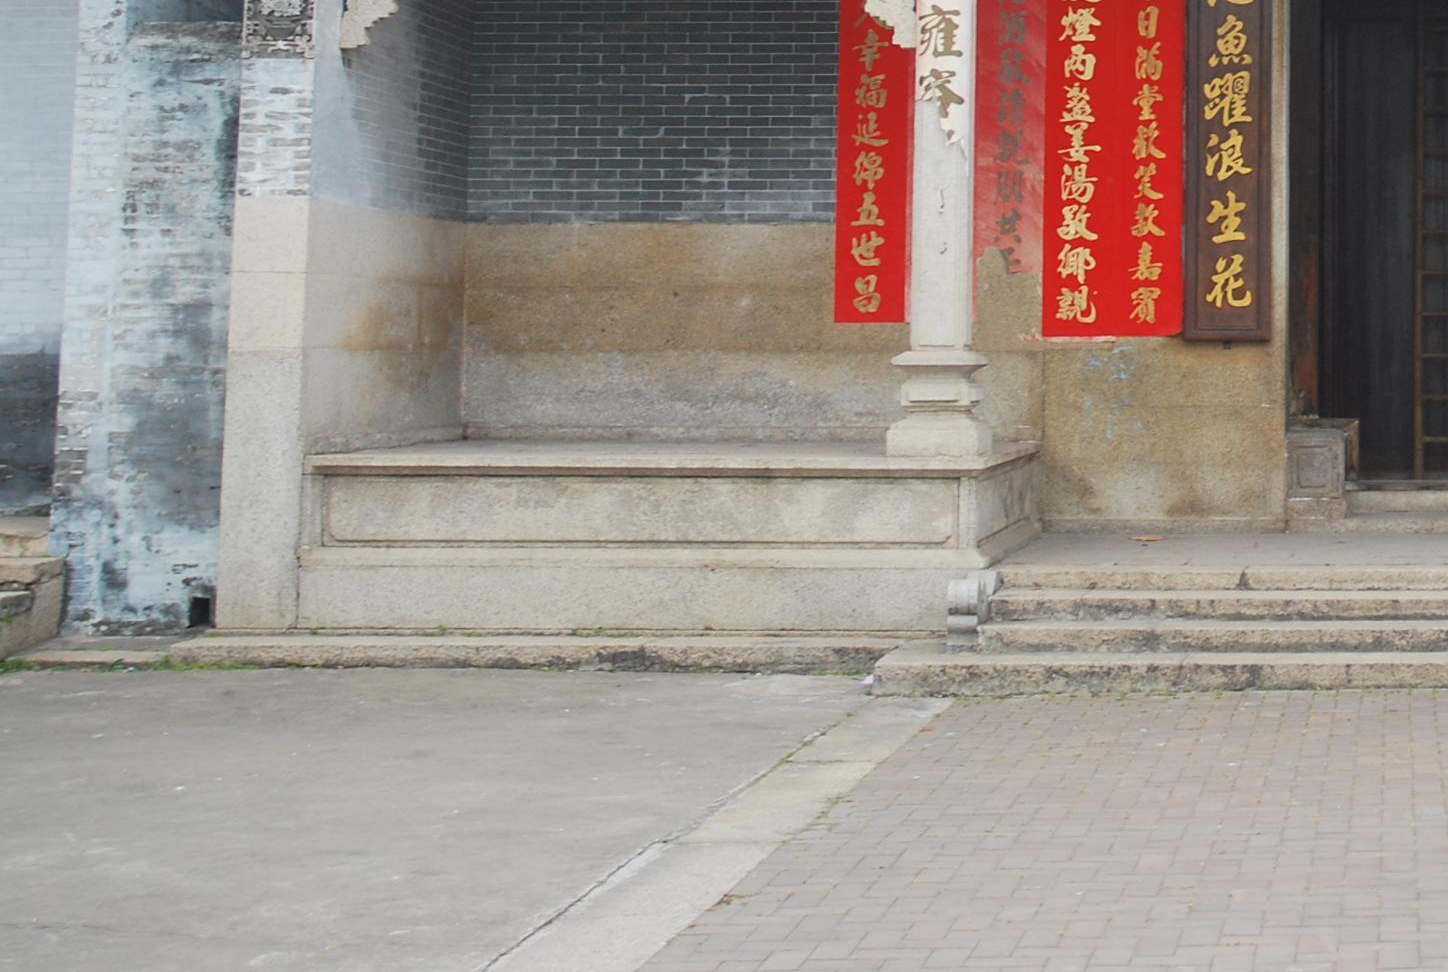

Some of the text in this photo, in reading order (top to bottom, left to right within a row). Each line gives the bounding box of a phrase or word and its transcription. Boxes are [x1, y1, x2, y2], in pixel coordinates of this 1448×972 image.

[852, 5, 889, 314] 幸福延綿五世昌
